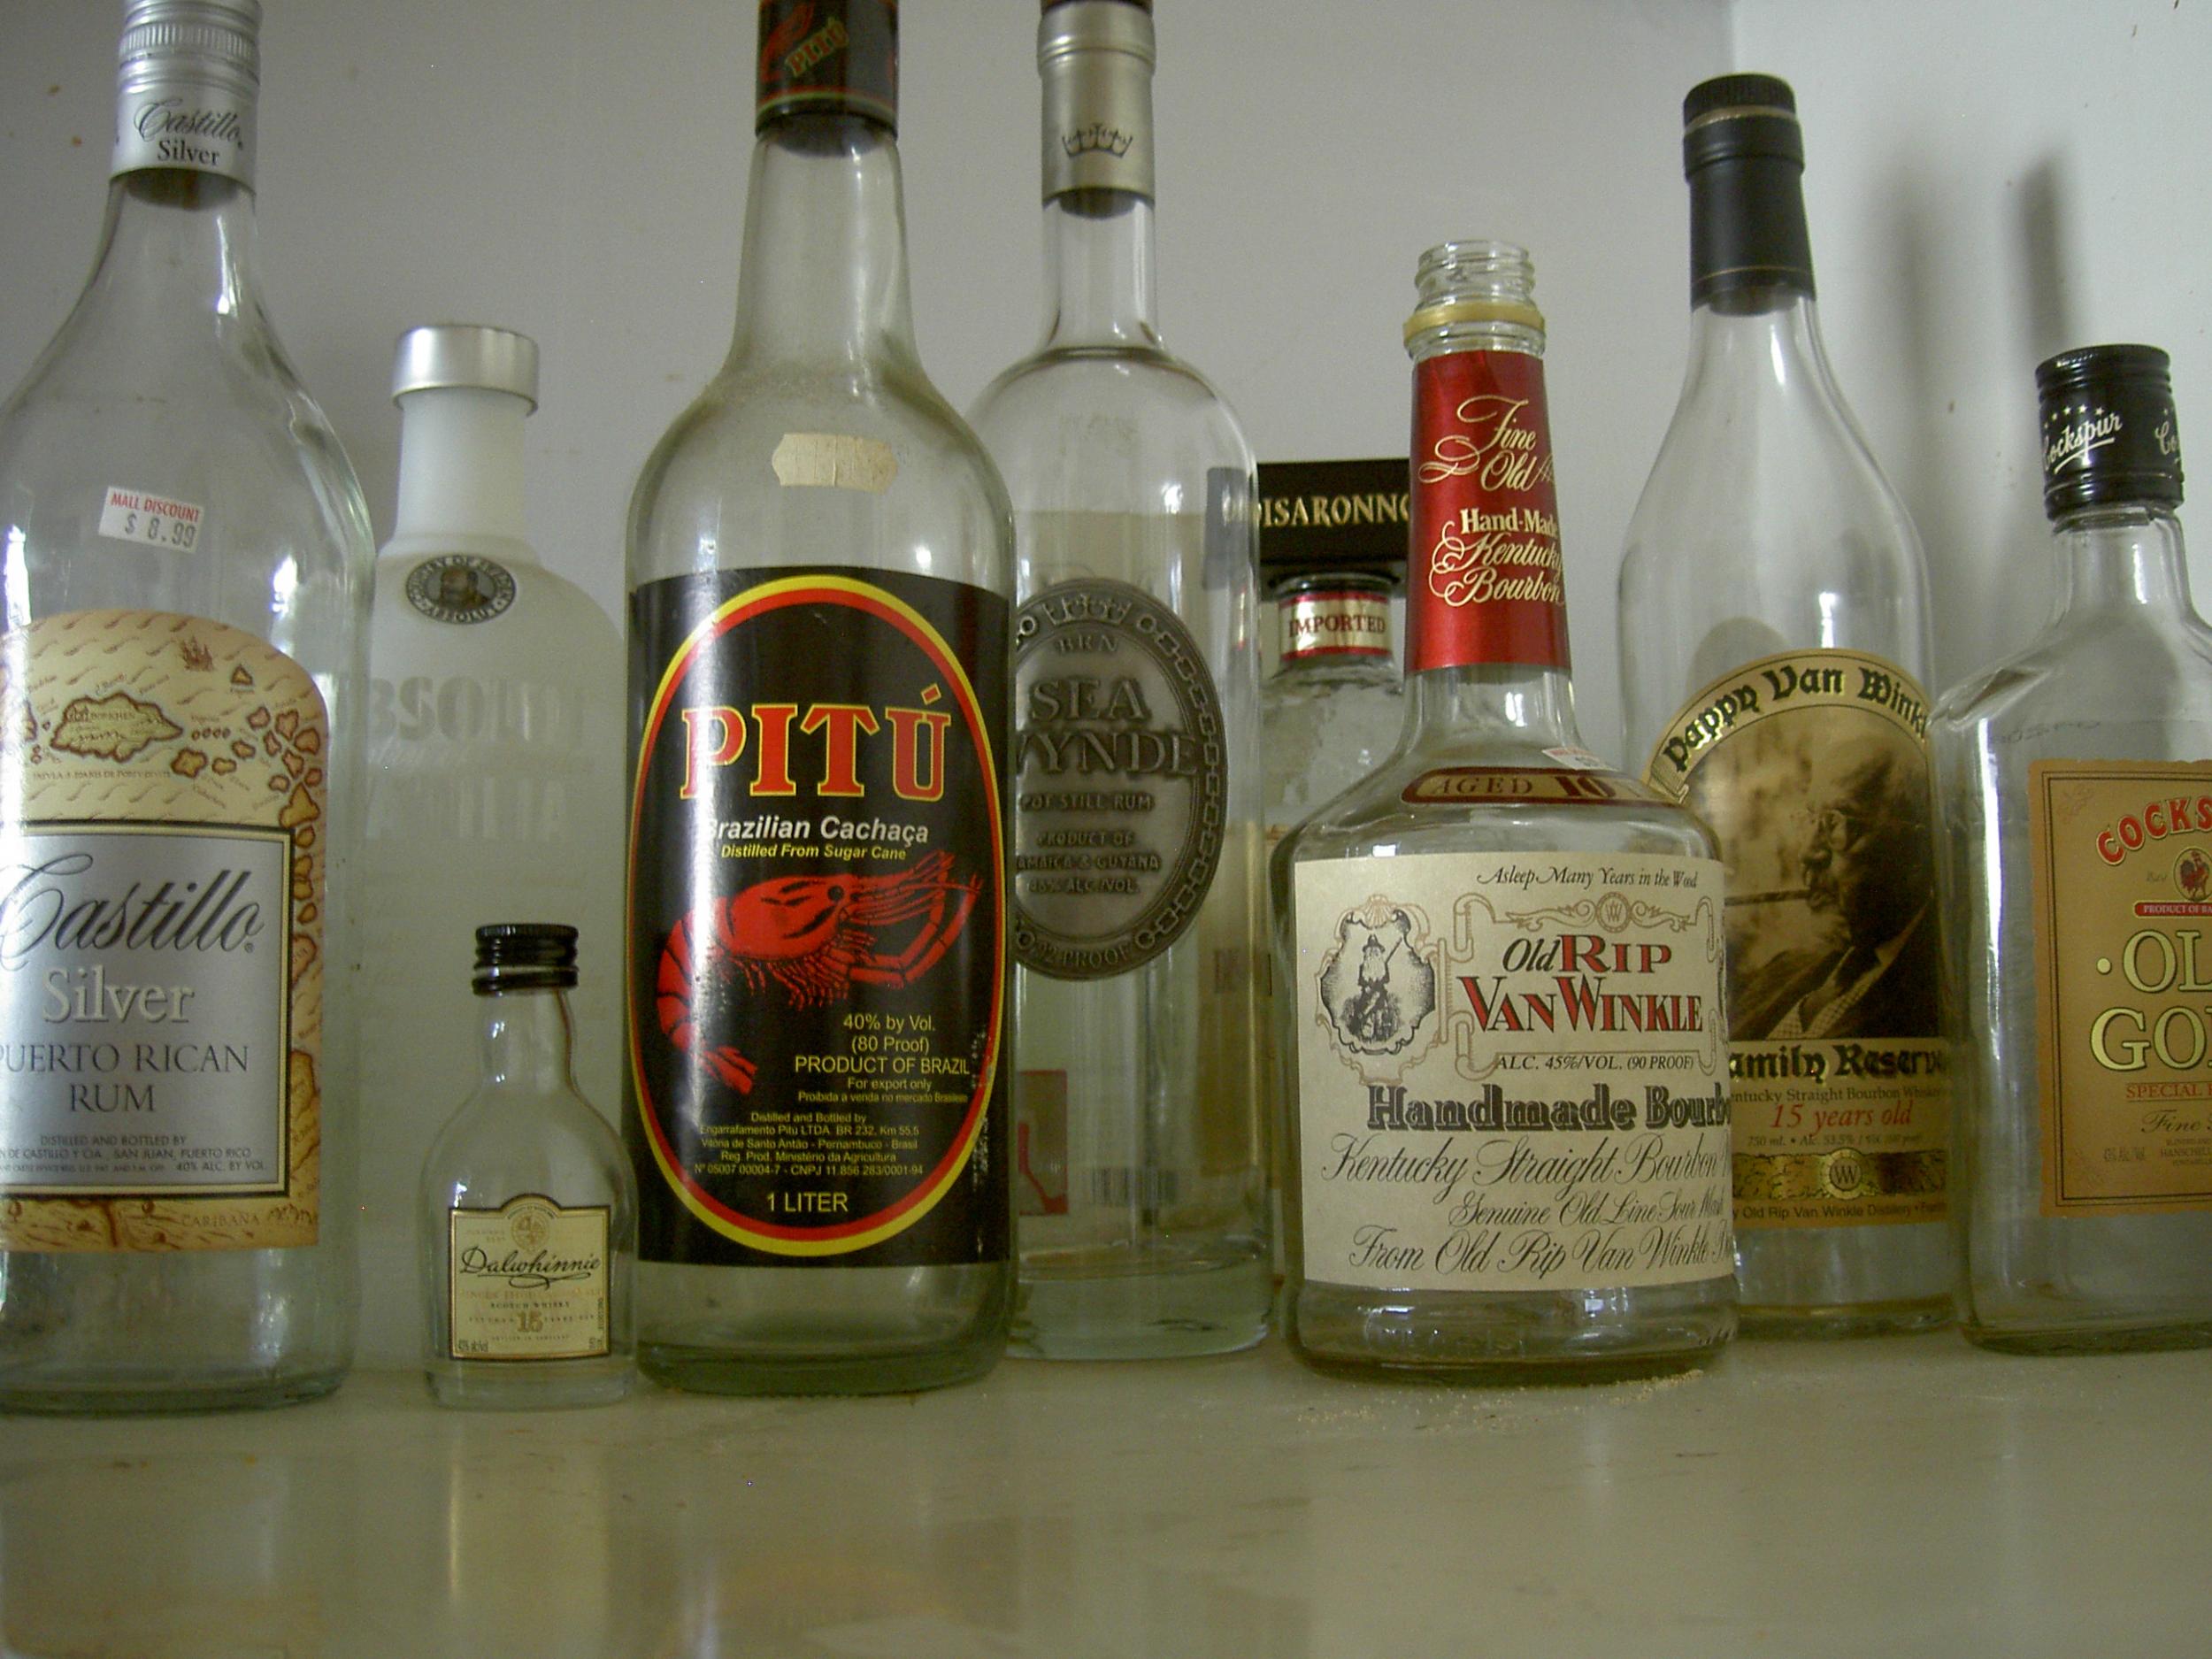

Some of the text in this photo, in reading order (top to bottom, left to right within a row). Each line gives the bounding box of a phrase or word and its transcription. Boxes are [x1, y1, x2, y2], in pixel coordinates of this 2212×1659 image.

[134, 97, 242, 149] Castillo
[157, 139, 220, 167] Silver
[1437, 395, 1536, 455] Fine
[2042, 411, 2124, 472] Cockspur
[1479, 449, 1541, 491] Old
[111, 493, 199, 523] MALL DISCOUNT
[1437, 531, 1563, 581] Kentucky
[1429, 565, 1564, 607] Bourbon
[1289, 615, 1386, 637] IMPORTED
[1030, 680, 1146, 722] SEA
[1663, 683, 1761, 772] Pappy
[1762, 664, 1844, 702] Van
[680, 683, 952, 802] PITÚ
[1431, 775, 1533, 795] AGED
[1553, 775, 1617, 797] 10
[1060, 793, 1105, 809] STILL
[1112, 793, 1154, 809] RUM
[819, 815, 929, 848] Cachaça
[1036, 830, 1135, 847] PRODUCT OF
[720, 843, 907, 862] Distilled From Sugar Cane
[1078, 855, 1093, 870] &
[1095, 855, 1160, 871] GUYANA
[1477, 865, 1699, 891] Asleep Many Years in the Wood
[0, 852, 265, 972] Castillo
[2143, 903, 2199, 914] PRODUCT OF
[1061, 939, 1133, 969] PROOF
[1503, 934, 1673, 974] Old RIP
[43, 965, 196, 1024] Silver
[1456, 974, 1704, 1033] VAN WINKLE
[842, 1013, 935, 1035] 40% by Vol.
[851, 1035, 930, 1056] (80 Proof)
[135, 1045, 250, 1074] RICAN
[795, 1056, 971, 1076] PRODUCT OF BRAZIL
[1497, 1055, 1694, 1071] ALC. 45%/VOL. (90 PROOF)
[1729, 1044, 1829, 1085] amily
[70, 1084, 155, 1112] RUM
[798, 1091, 839, 1103] Proibida
[850, 1094, 879, 1103] venda
[896, 1093, 933, 1104] mercado
[847, 1077, 933, 1094] For export only
[1731, 1087, 1901, 1104] entucky Straight Bourbon
[2126, 1082, 2202, 1099] SPECIAL
[751, 1112, 867, 1126] Distilled and Bottled by
[1367, 1082, 1638, 1132] Handmade
[1770, 1100, 1915, 1138] 15 years old
[836, 1125, 852, 1136] BR
[879, 1125, 896, 1136] Km
[2141, 1109, 2202, 1134] Fine
[23, 1149, 69, 1159] CASTILLO
[113, 1149, 139, 1159] SAN
[180, 1148, 223, 1159] PUERTO
[226, 1148, 251, 1159] RICO
[41, 1134, 187, 1147] DISTILLED AND BOTTLED BY
[733, 1139, 744, 1148] de
[747, 1138, 778, 1149] Santo
[779, 1138, 809, 1149] Antão
[818, 1139, 883, 1149] Pernambuco
[229, 1161, 242, 1171] BY
[790, 1164, 823, 1175] CNPJ
[827, 1152, 841, 1163] da
[843, 1152, 897, 1164] Agricultura
[1322, 1133, 1468, 1203] Kentucky
[1472, 1137, 1618, 1202] Straight
[1614, 1132, 1718, 1185] Bourbon
[767, 1193, 849, 1212] 1 LITER
[1448, 1190, 1551, 1229] Genuine
[1558, 1193, 1604, 1226] Old
[1600, 1190, 1658, 1225] Line
[1743, 1205, 1765, 1219] Old
[1769, 1206, 1789, 1220] Rip
[1793, 1205, 1819, 1217] Van
[1821, 1204, 1864, 1217] Winkle
[460, 1246, 602, 1279] Dalwhinnie
[1348, 1225, 1425, 1272] From
[1435, 1226, 1498, 1275] Old
[1497, 1226, 1568, 1281] Rip
[1570, 1227, 1637, 1273] Van
[1639, 1225, 1711, 1271] Winkle
